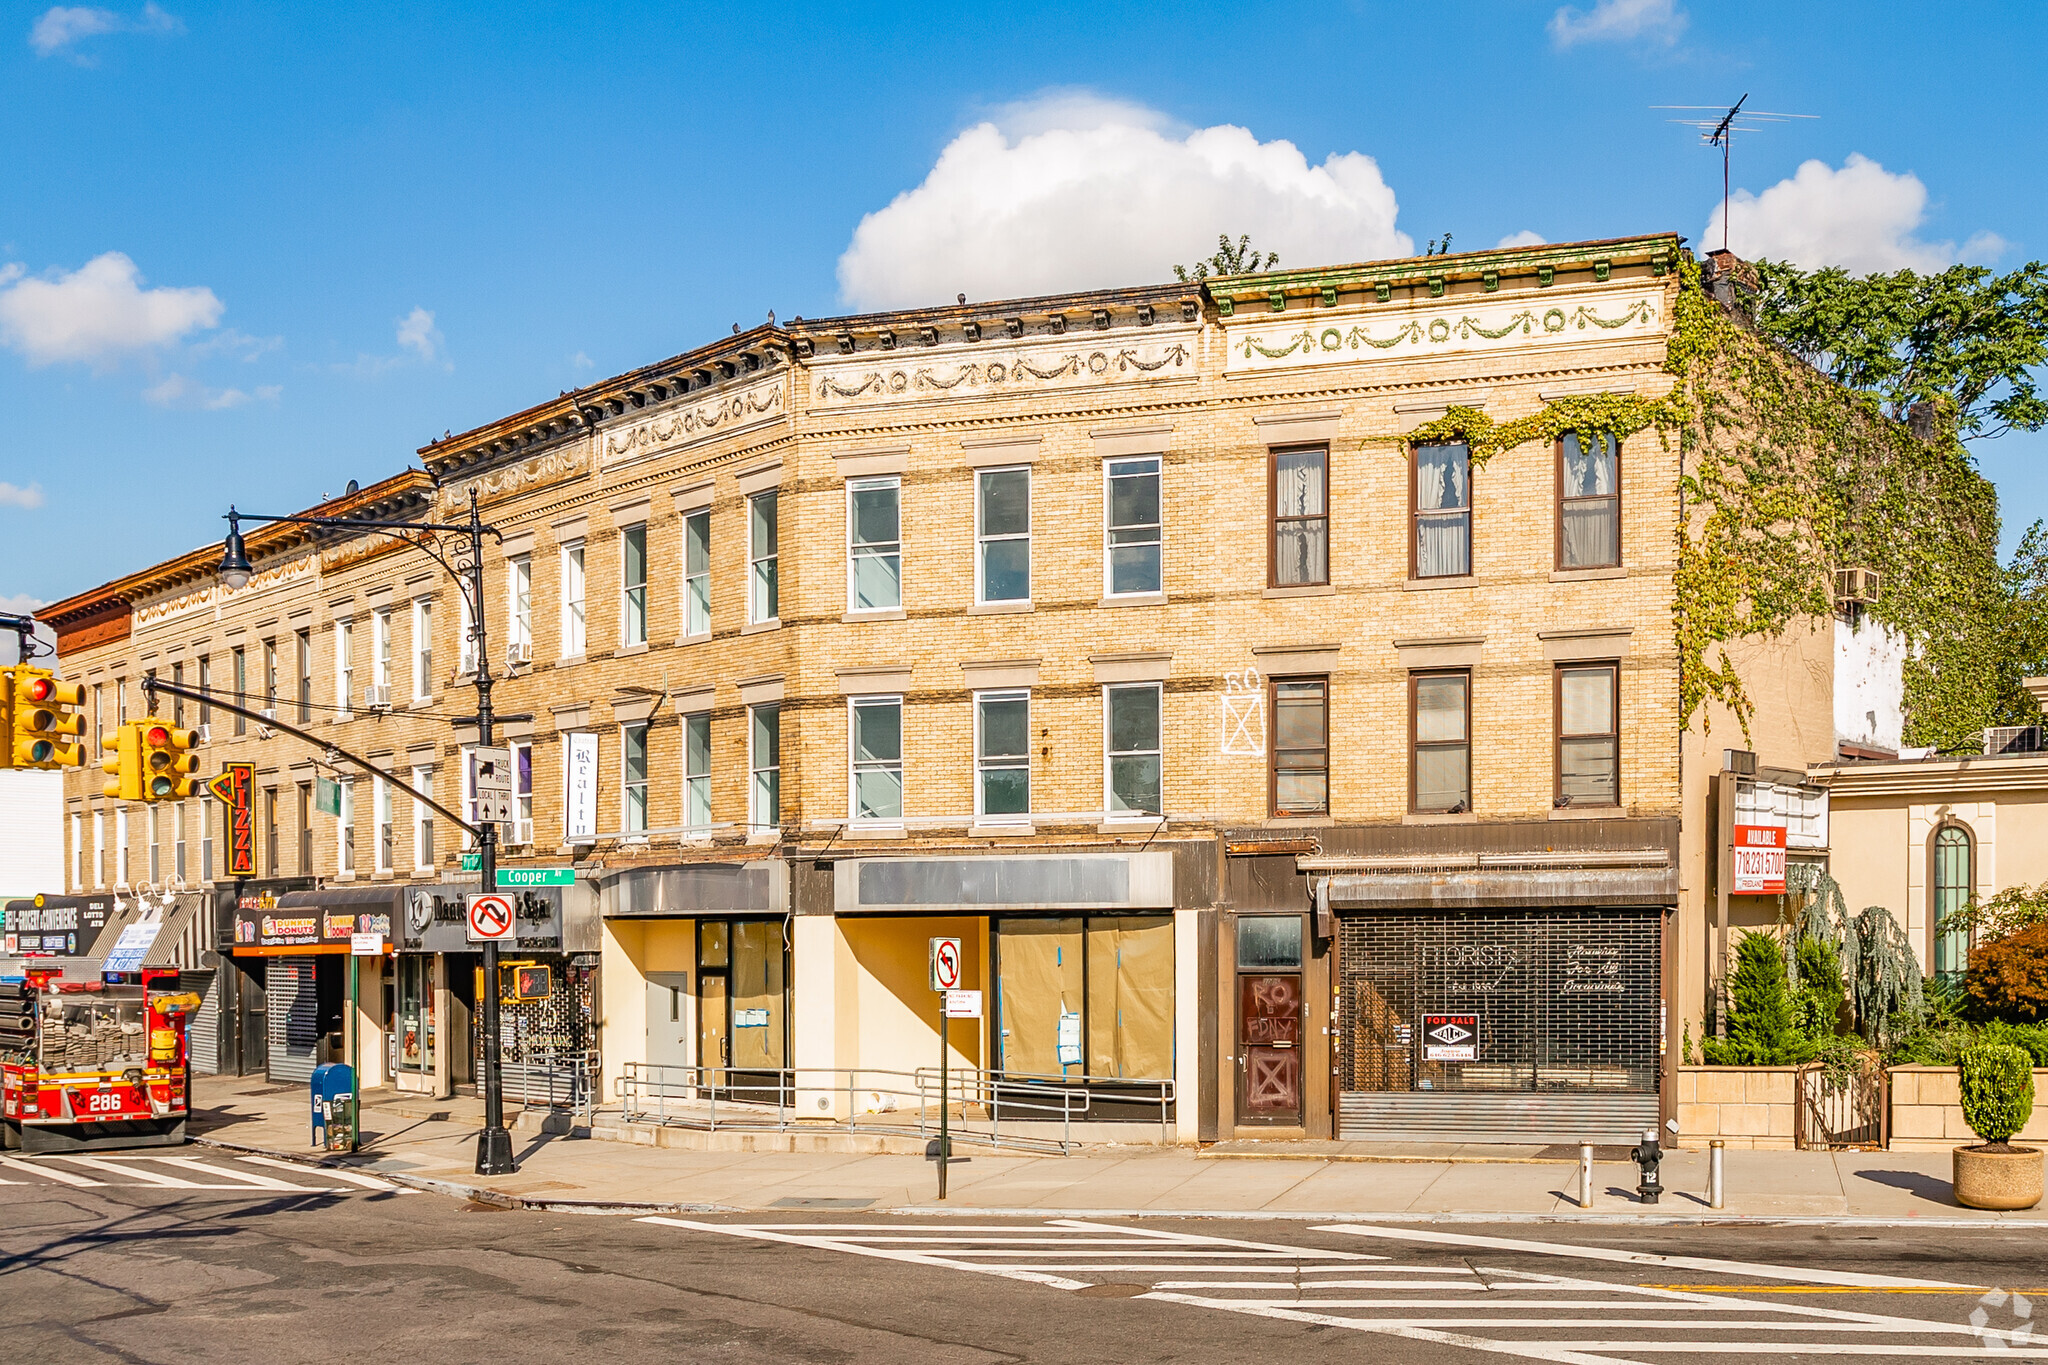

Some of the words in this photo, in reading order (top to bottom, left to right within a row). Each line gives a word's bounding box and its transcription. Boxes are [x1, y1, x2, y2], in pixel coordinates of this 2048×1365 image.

[495, 759, 509, 768] TRUCK
[496, 774, 509, 784] ROUTE
[479, 790, 493, 800] LOCAL
[576, 749, 591, 834] Realty
[234, 768, 251, 870] PIZZA
[1747, 829, 1776, 845] AVAILABLE
[508, 870, 547, 885] Cooper
[83, 911, 104, 919] LOTTO
[277, 919, 316, 927] DUNKIN'
[331, 926, 354, 938] DONUTS
[1422, 945, 1507, 966] FLORIST
[1248, 1019, 1293, 1041] FDNY
[90, 1094, 121, 1111] 286
